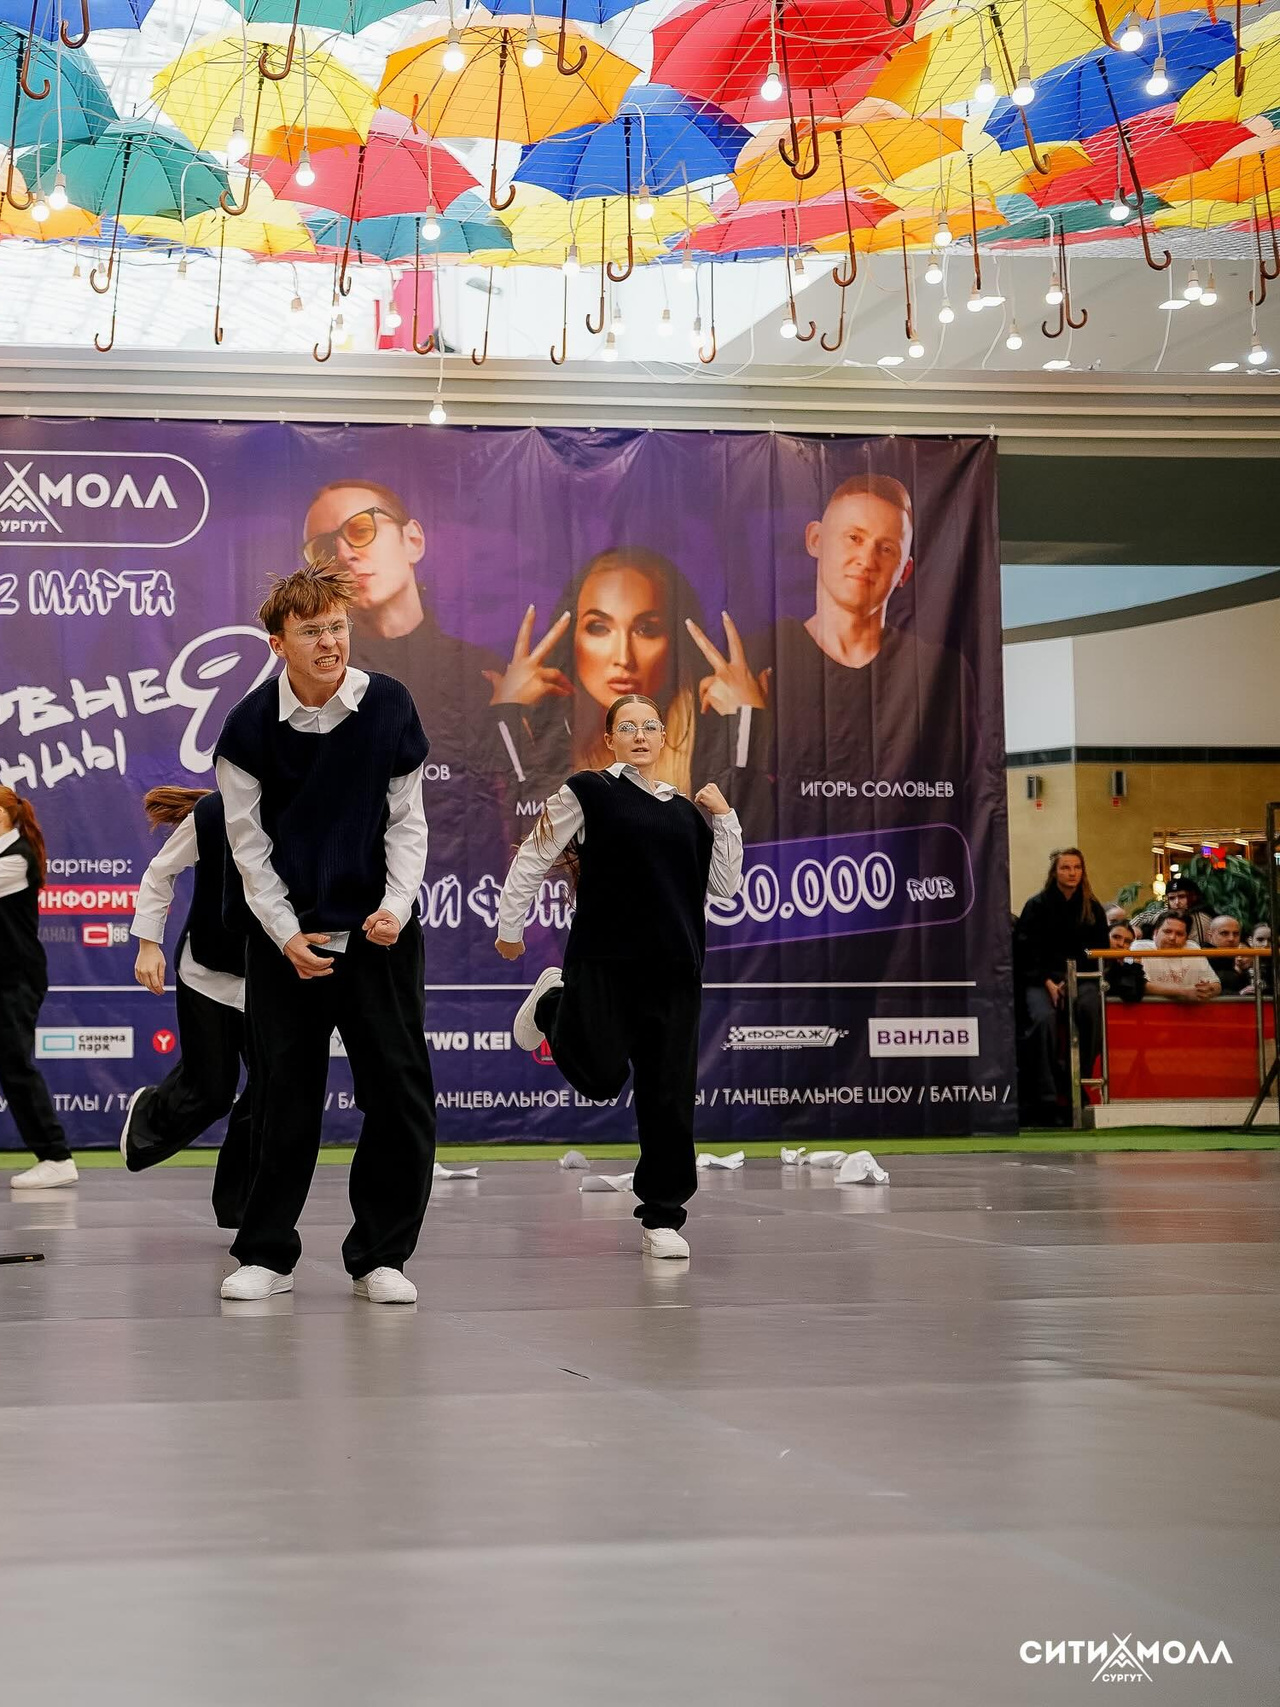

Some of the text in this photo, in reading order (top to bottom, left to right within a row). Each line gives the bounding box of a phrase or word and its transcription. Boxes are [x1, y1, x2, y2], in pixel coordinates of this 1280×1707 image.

[37, 473, 179, 510] МОЛЛ
[27, 568, 176, 617] МАРТА
[800, 780, 955, 798] ИГОРЬ СОЛОВЬЕВ
[906, 876, 956, 902] RUB
[78, 1034, 126, 1043] синема
[747, 1030, 824, 1040] ФОРСАЖ
[876, 1028, 970, 1046] ванлав
[78, 1043, 110, 1054] парк
[435, 1090, 570, 1110] АНЦЕВАЛЬНОЕ
[722, 1086, 863, 1108] ТАНЦЕВАЛЬНОЕ
[867, 1086, 913, 1105] ШОУ
[930, 1085, 997, 1104] БАТТЛЫ
